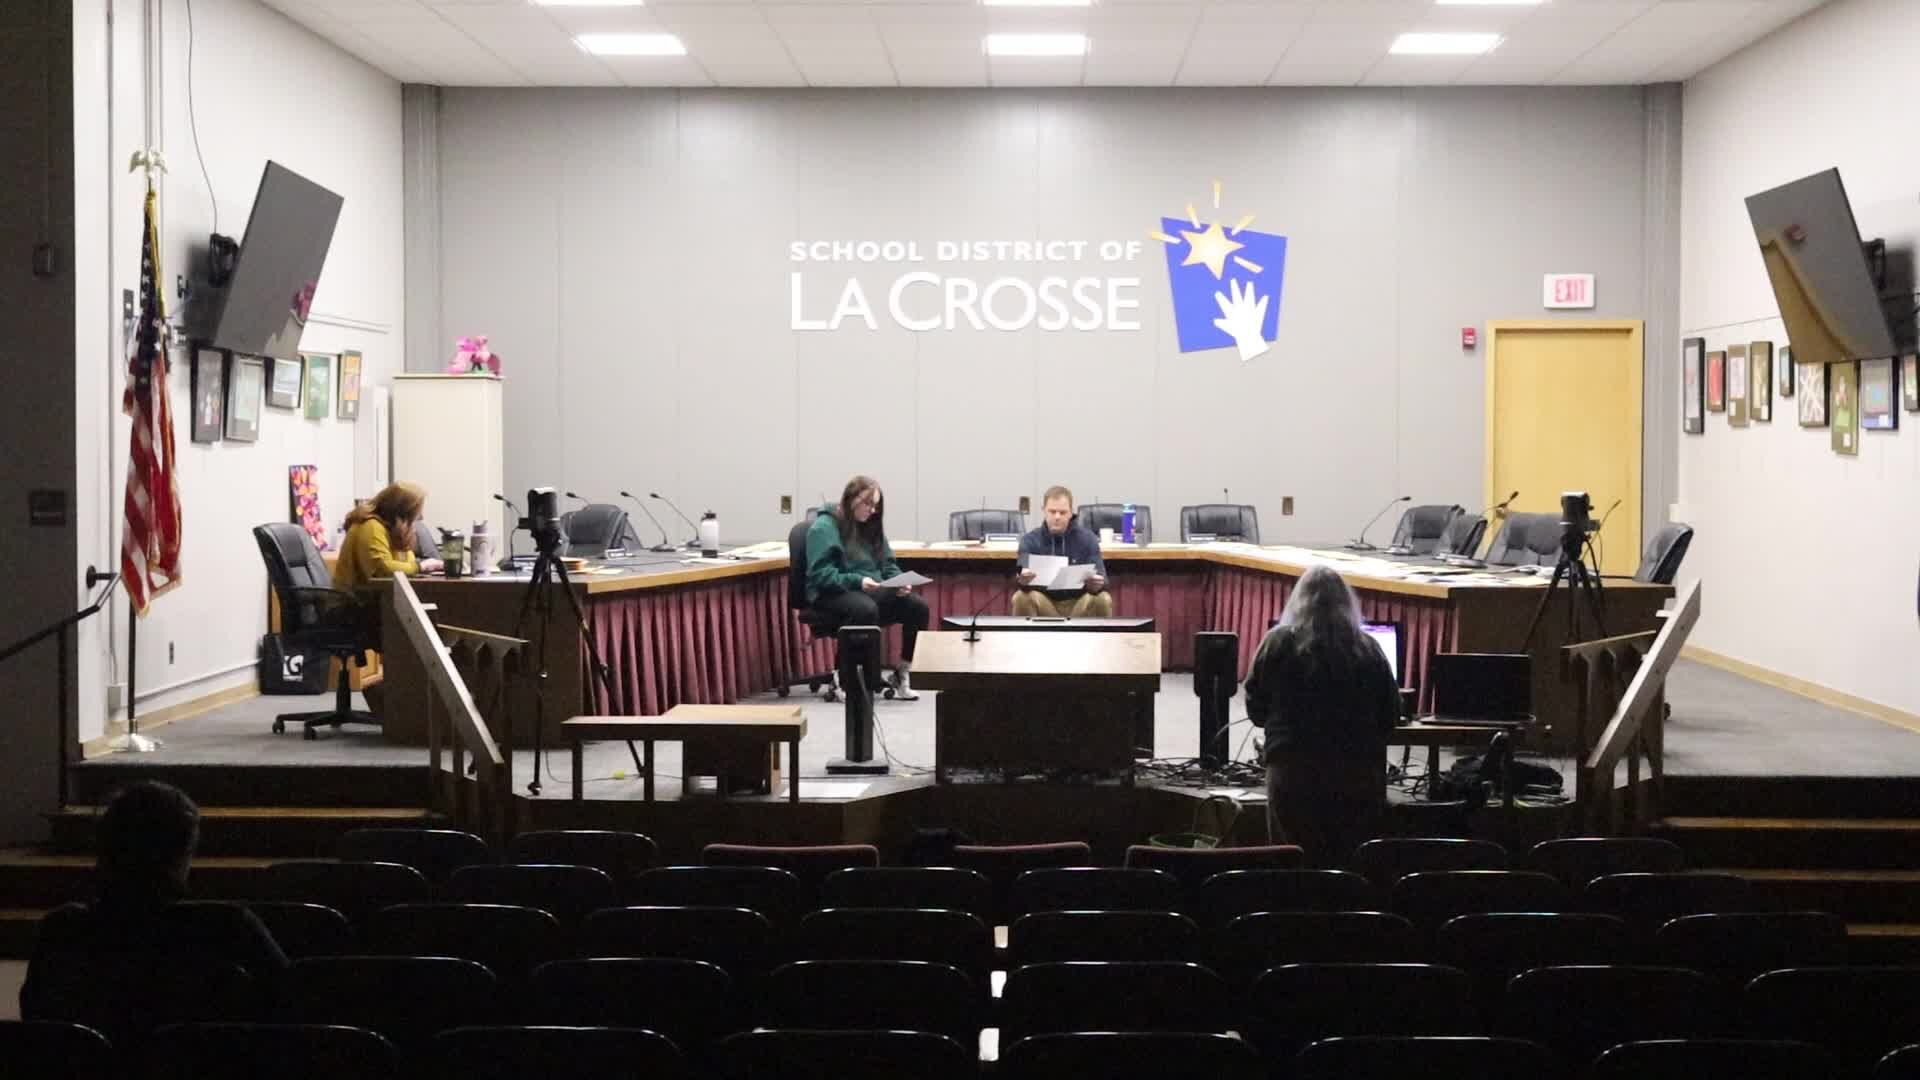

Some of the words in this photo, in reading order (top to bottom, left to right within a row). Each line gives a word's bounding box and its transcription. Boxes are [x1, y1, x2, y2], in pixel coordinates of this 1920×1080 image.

[790, 240, 923, 262] SCHOOL
[937, 240, 1089, 262] DISTRICT
[1100, 240, 1142, 262] OF
[790, 271, 879, 331] LA
[888, 271, 1141, 331] CROSSE
[1555, 279, 1586, 304] EXIT
